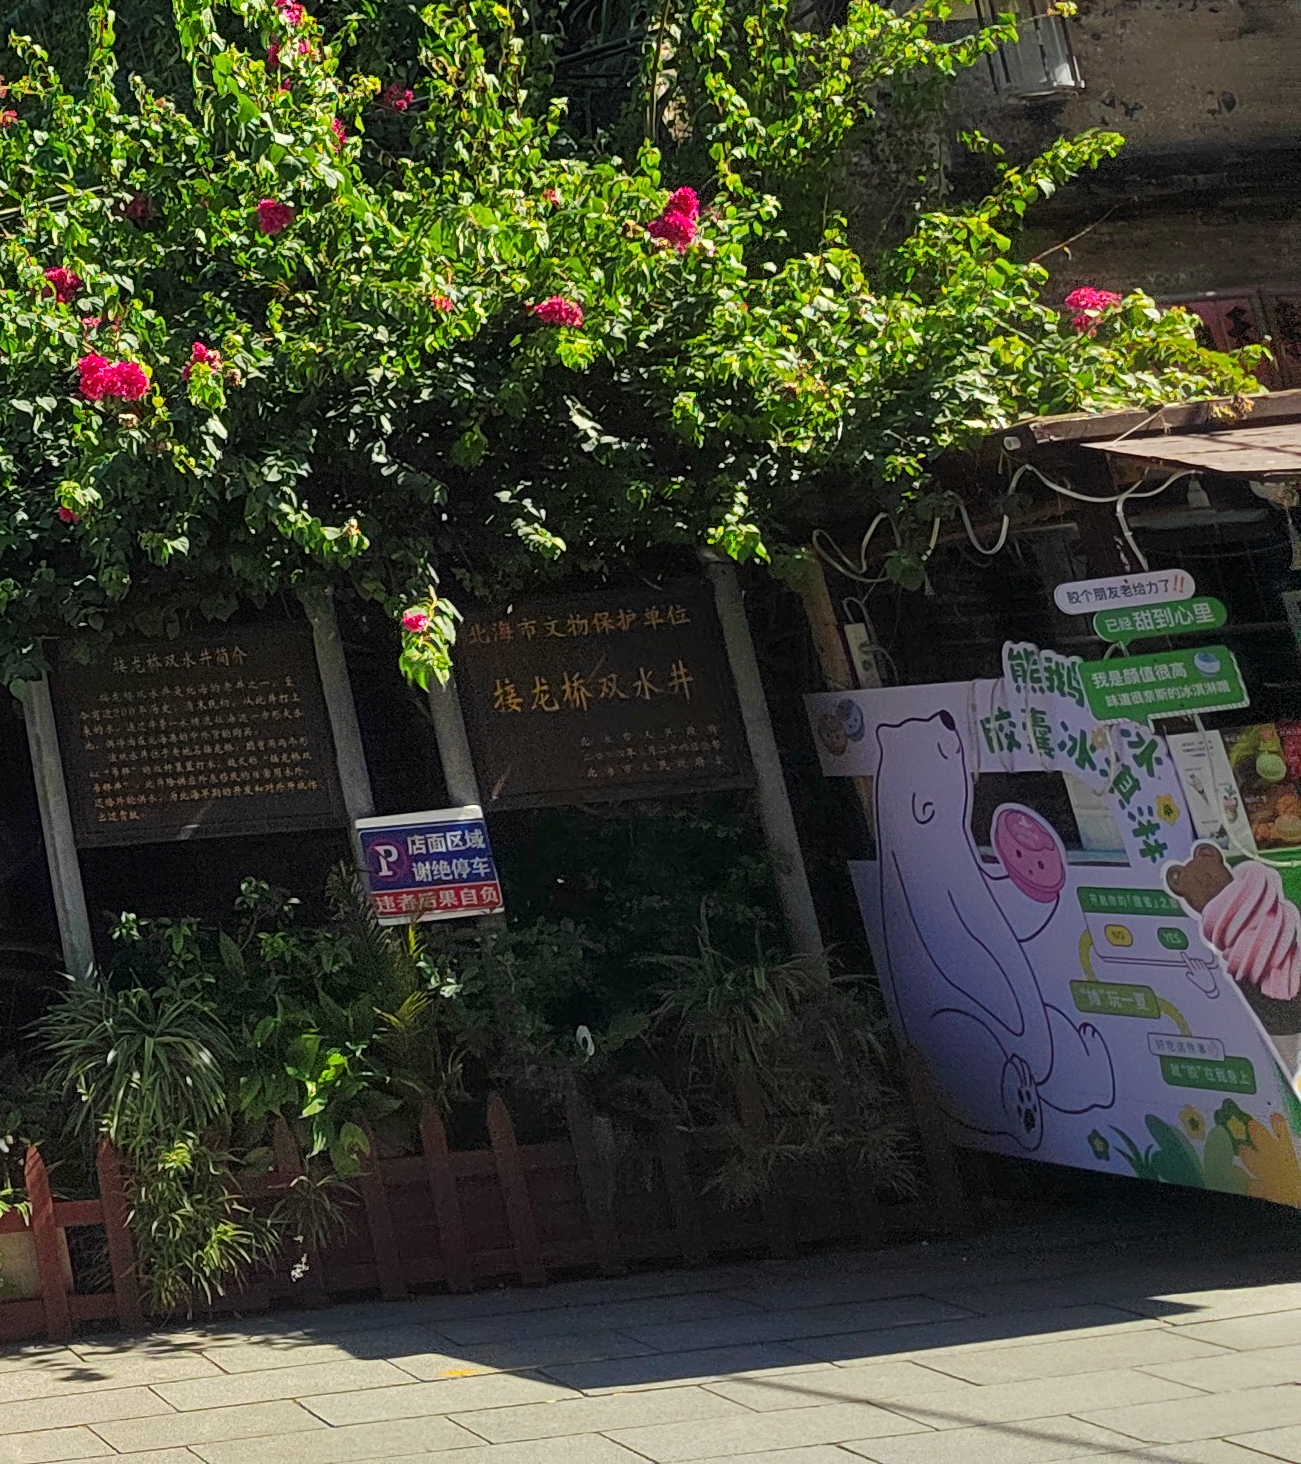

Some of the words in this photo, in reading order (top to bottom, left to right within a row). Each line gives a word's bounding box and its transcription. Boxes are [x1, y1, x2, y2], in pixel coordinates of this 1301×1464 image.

[468, 604, 691, 645] 北海市文物保护单位
[1104, 602, 1215, 633] 已经甜到心里
[493, 658, 695, 713] 接龙桥双水井
[1091, 662, 1188, 689] 我是颜值很高
[407, 829, 486, 855] 店面区域
[412, 856, 491, 882] 谢绝停车
[375, 886, 499, 913] 违者后果自负
[1162, 932, 1182, 944] YES
